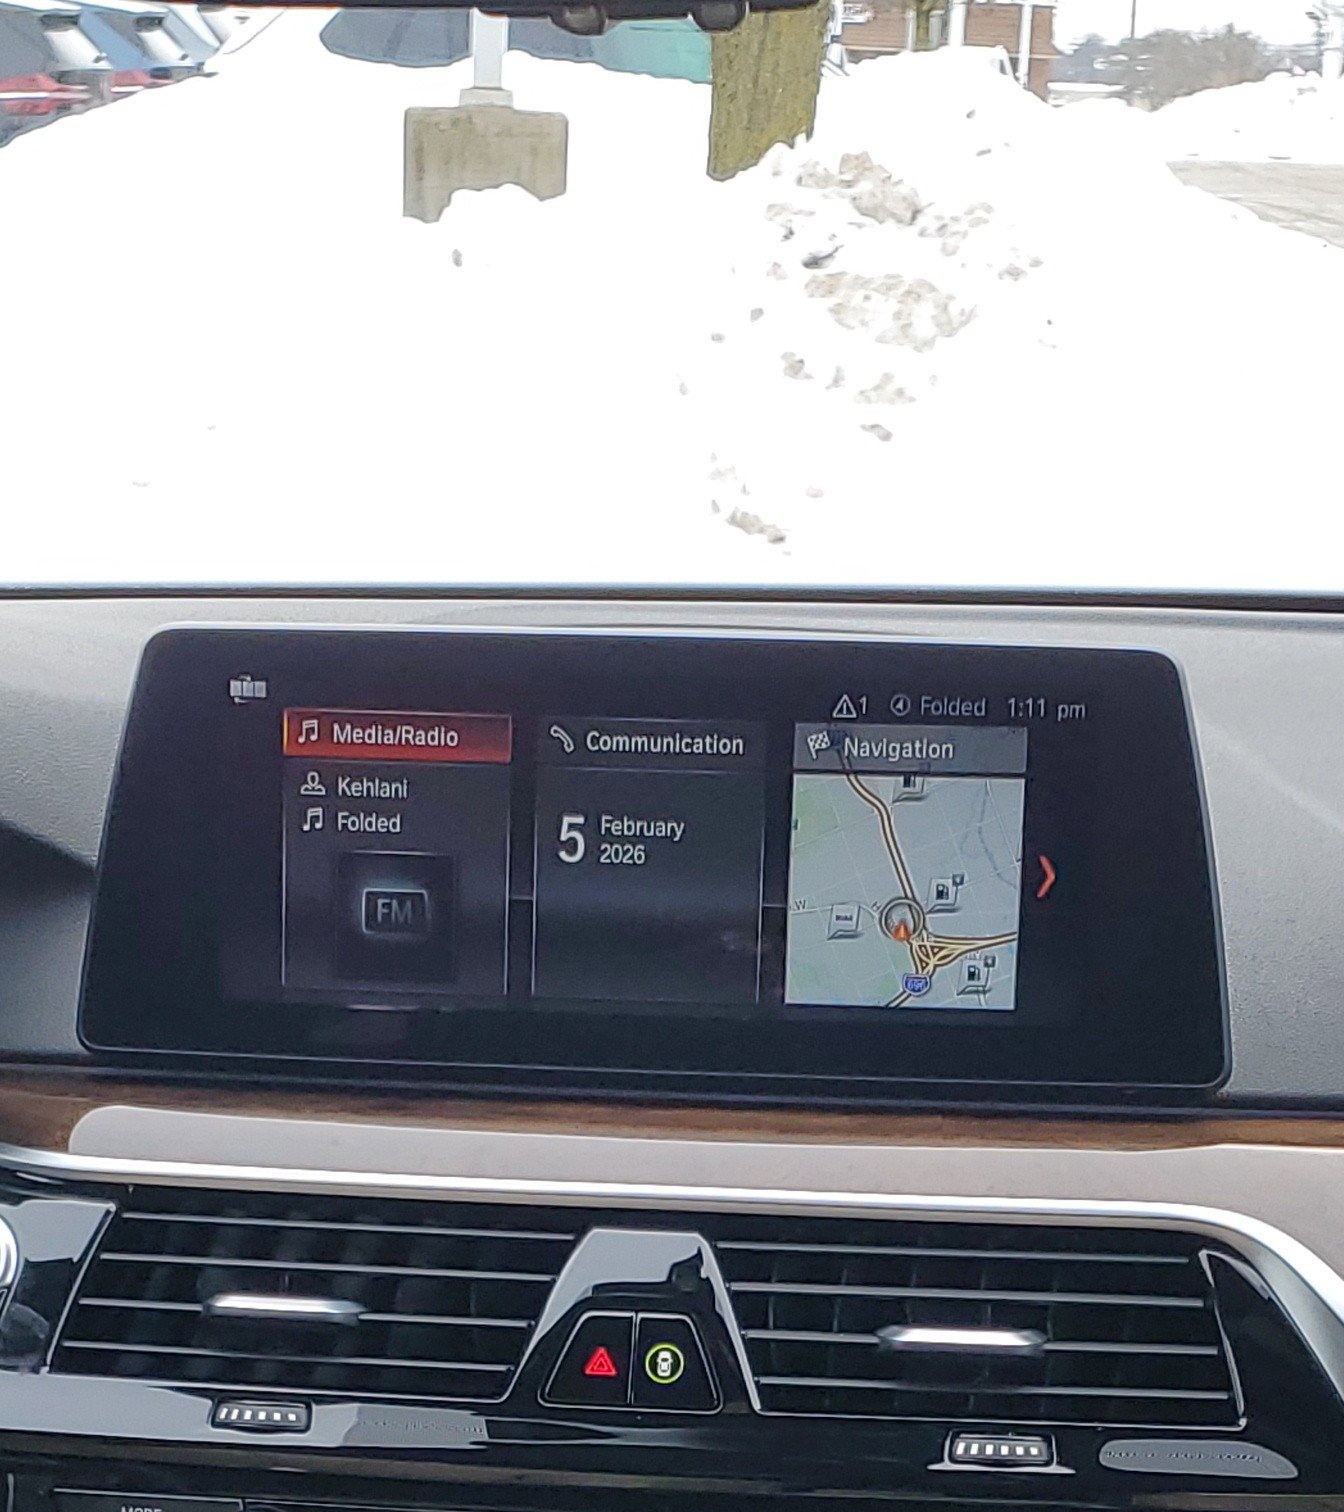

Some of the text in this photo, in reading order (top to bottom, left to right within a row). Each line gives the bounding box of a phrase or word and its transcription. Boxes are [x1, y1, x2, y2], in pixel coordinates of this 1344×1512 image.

[920, 695, 987, 717] Folded
[1007, 697, 1087, 722] 1:11 pm
[332, 722, 460, 748] Media/Radio
[586, 730, 745, 755] Communication
[844, 736, 955, 762] Navigation
[337, 776, 409, 799] Kehlani
[337, 811, 402, 833] Folded
[600, 814, 685, 841] February
[557, 813, 586, 863] 5
[599, 843, 646, 865] 2026
[377, 898, 412, 923] FM
